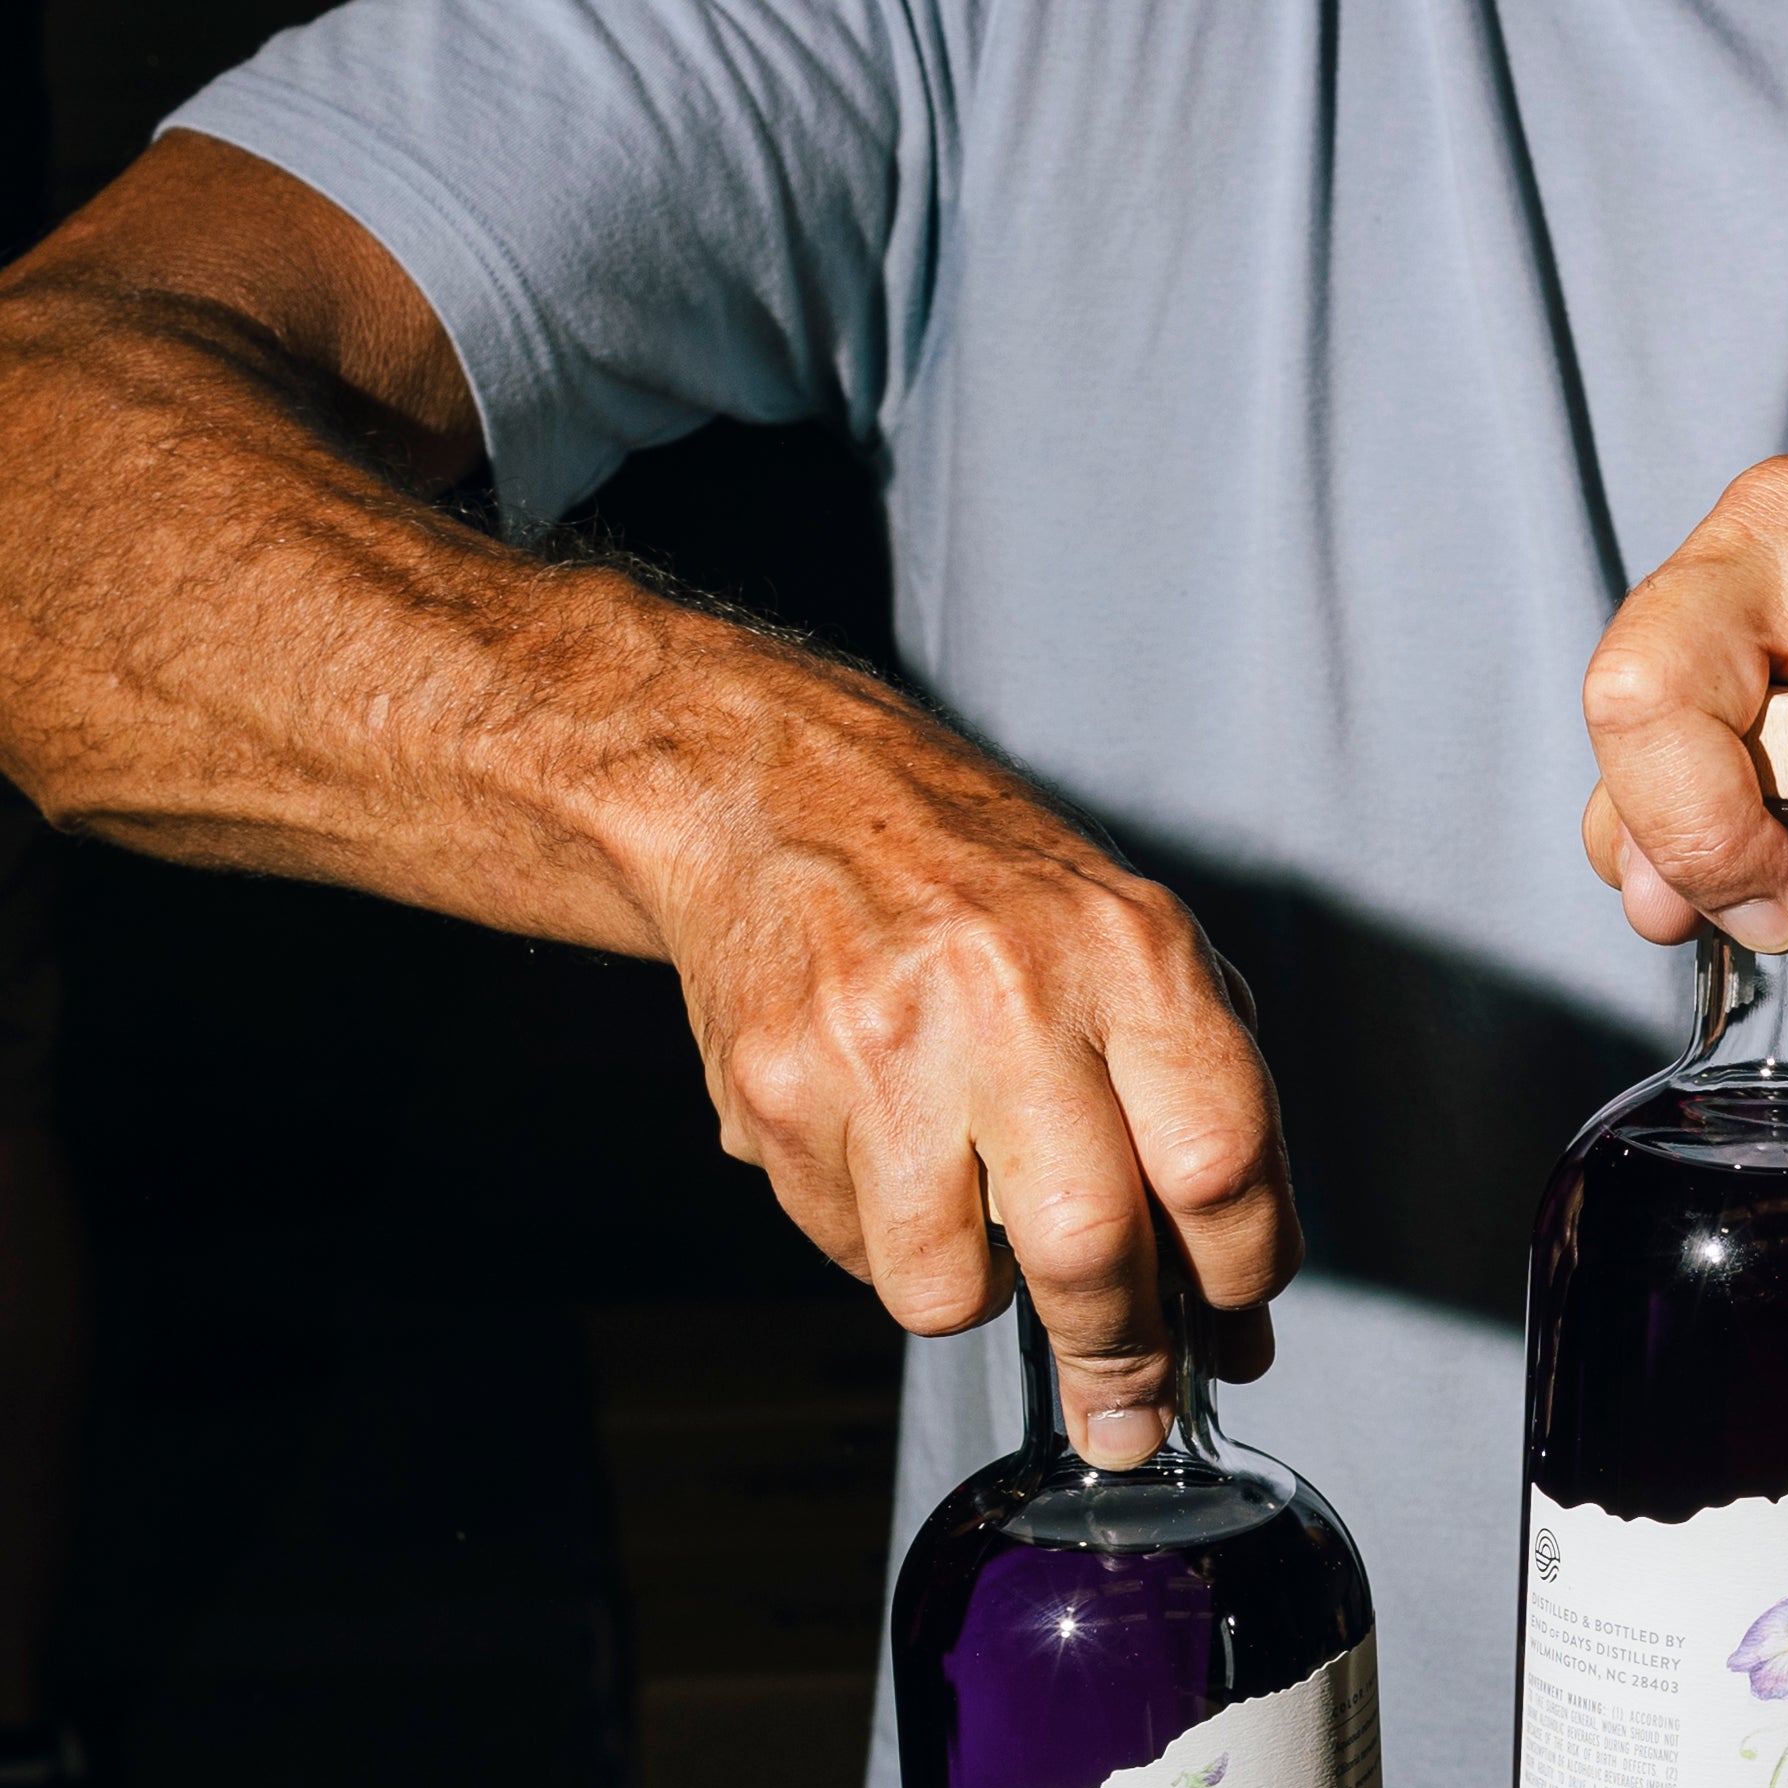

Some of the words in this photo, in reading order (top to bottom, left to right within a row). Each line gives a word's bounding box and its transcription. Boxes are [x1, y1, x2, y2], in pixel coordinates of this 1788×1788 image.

[1531, 1591, 1578, 1624] DISTILLED
[1582, 1615, 1591, 1629] &
[1595, 1619, 1660, 1645] BOTTLED
[1665, 1634, 1686, 1649] BY
[1531, 1614, 1547, 1634] END
[1562, 1631, 1592, 1652] DAYS
[1596, 1642, 1681, 1671] DISTILLERY
[1530, 1636, 1602, 1680] WILMINGTON,
[1606, 1667, 1627, 1684] NC
[1631, 1674, 1680, 1694] 28403
[1567, 1692, 1606, 1715] WARNING:
[1612, 1706, 1624, 1721] (1)
[1629, 1711, 1680, 1731] ACCORDING
[1602, 1720, 1627, 1737] WOMEN
[1630, 1727, 1660, 1744] SHOULD
[1664, 1734, 1680, 1748] NOT
[1603, 1738, 1630, 1755] DURING
[1634, 1744, 1679, 1764] PREGNANCY
[1596, 1752, 1617, 1768] BIRTH
[1665, 1767, 1679, 1782] (2)
